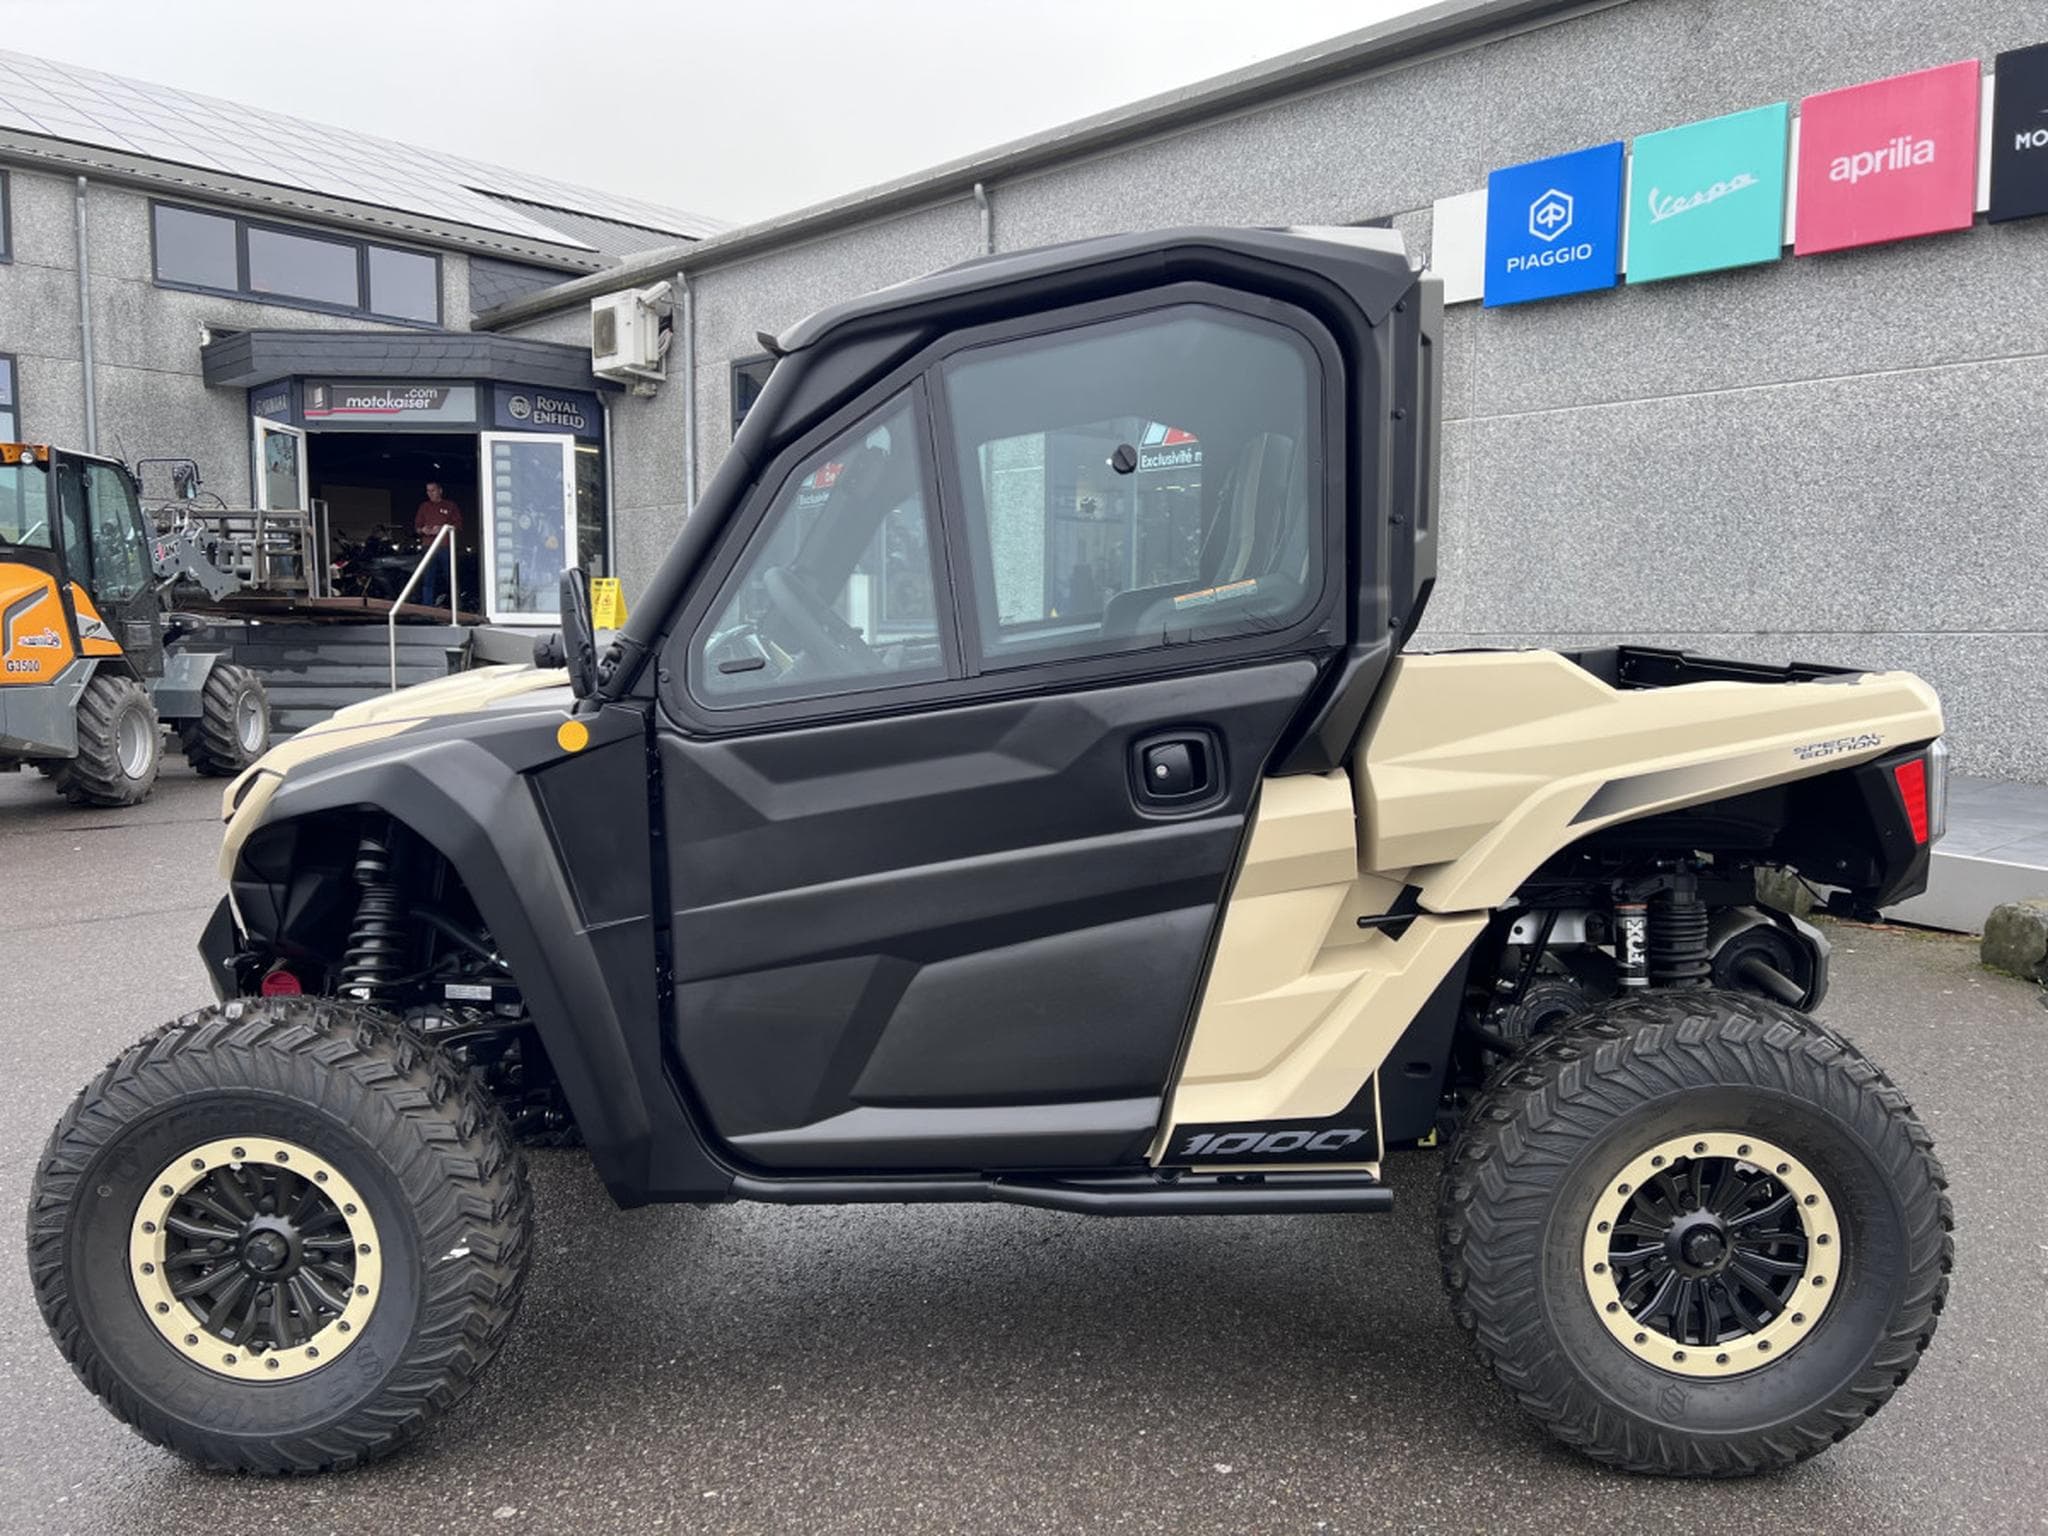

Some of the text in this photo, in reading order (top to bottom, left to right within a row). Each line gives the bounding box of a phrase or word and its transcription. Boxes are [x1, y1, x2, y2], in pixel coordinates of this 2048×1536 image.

[1829, 135, 1935, 184] aprilia
[1648, 173, 1759, 225] Vespa
[1507, 243, 1592, 273] PIAGGIO
[536, 396, 579, 414] ROYAL
[533, 411, 585, 430] ENFIELD
[1141, 448, 1193, 469] Exclusivité
[6, 660, 41, 672] G3500
[1793, 732, 1885, 755] SPECIAL
[1800, 740, 1880, 760] EDITION
[1626, 920, 1646, 964] FOX
[1179, 1129, 1369, 1156] 1000
